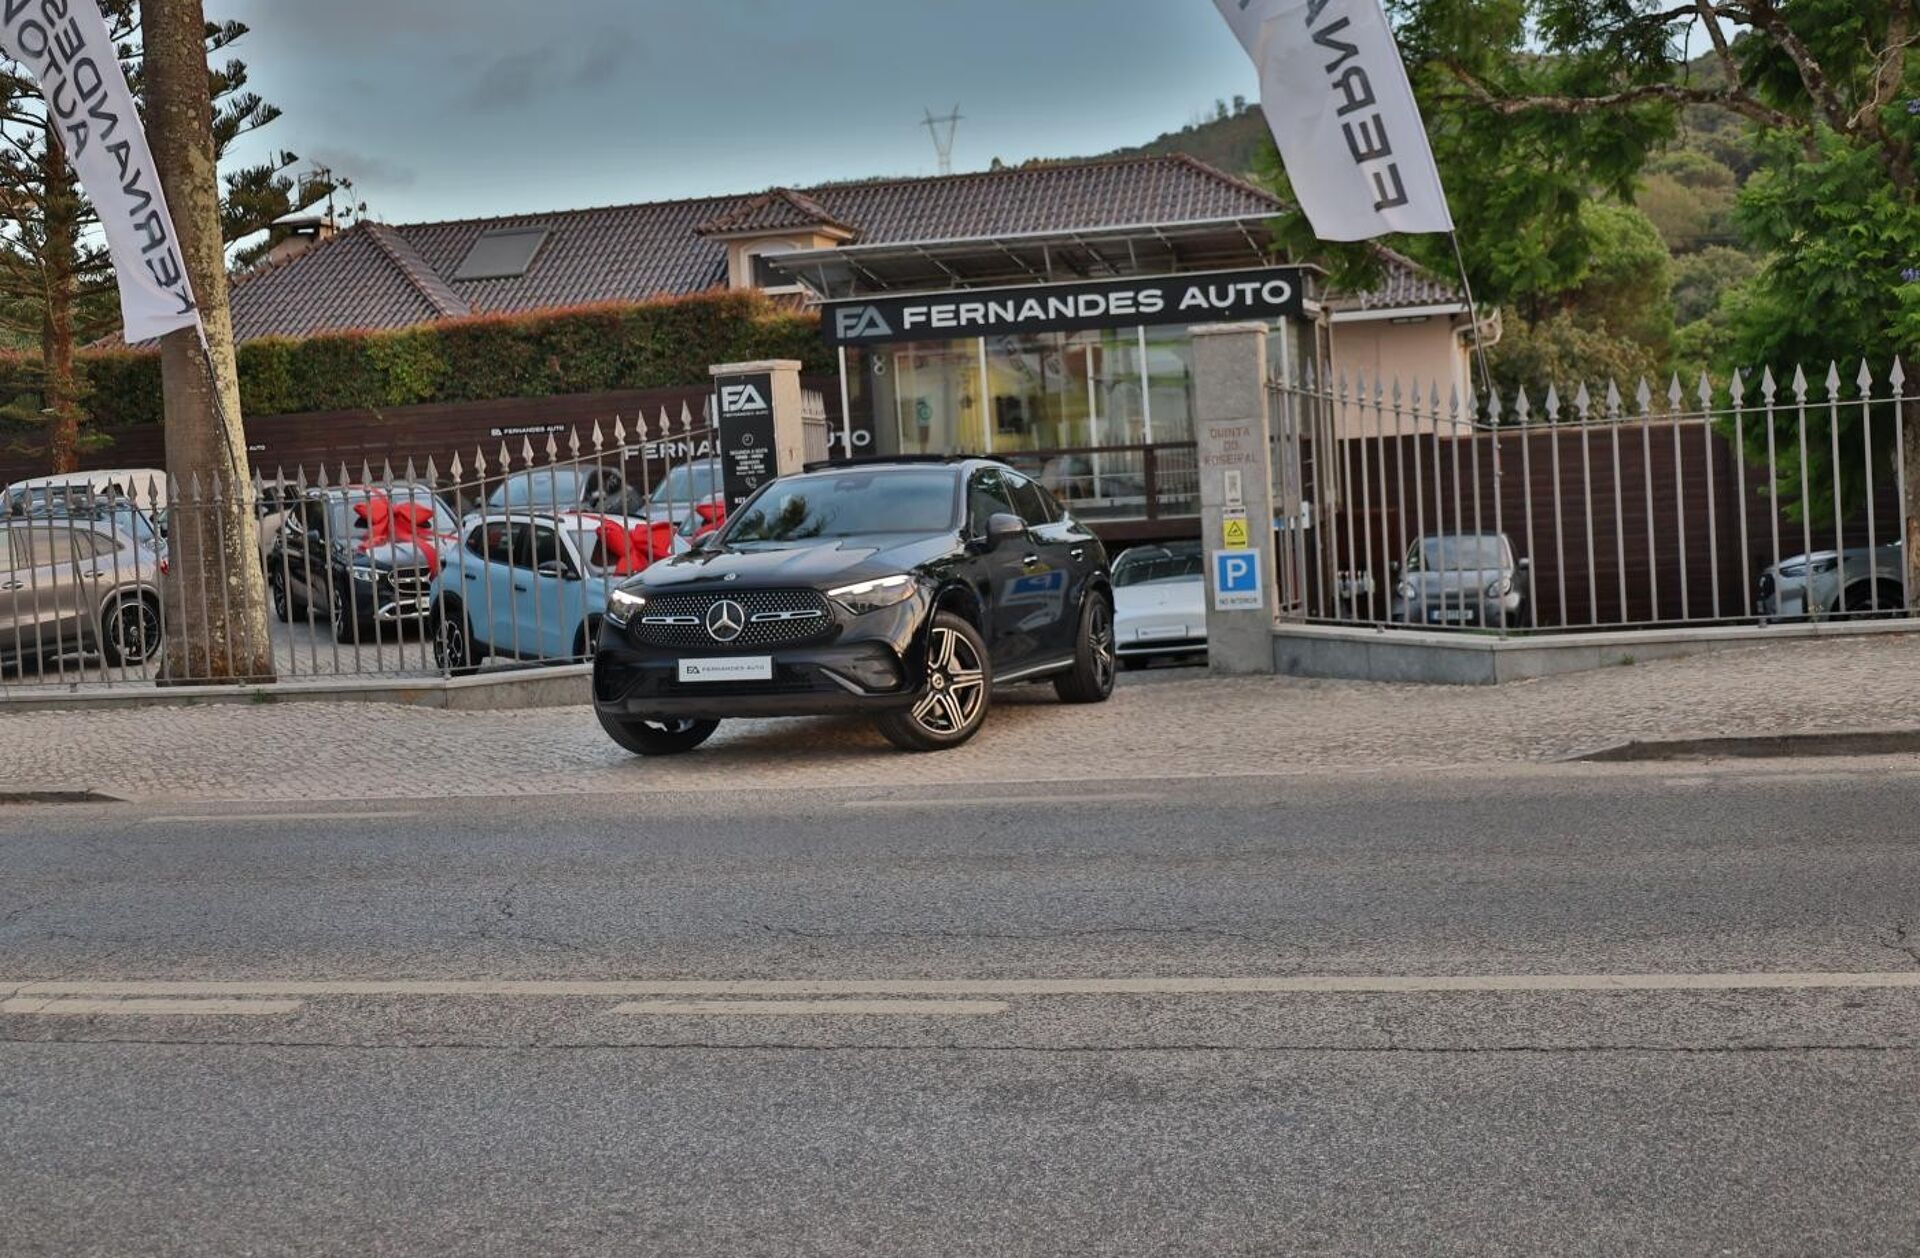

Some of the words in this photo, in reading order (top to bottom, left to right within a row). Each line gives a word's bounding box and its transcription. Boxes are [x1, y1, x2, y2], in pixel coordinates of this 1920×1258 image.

[835, 306, 893, 340] FA
[902, 288, 1164, 330] FERNANDES
[1179, 280, 1292, 311] AUTO
[721, 384, 768, 412] FA
[624, 439, 721, 461] FERNA
[1226, 559, 1248, 588] P
